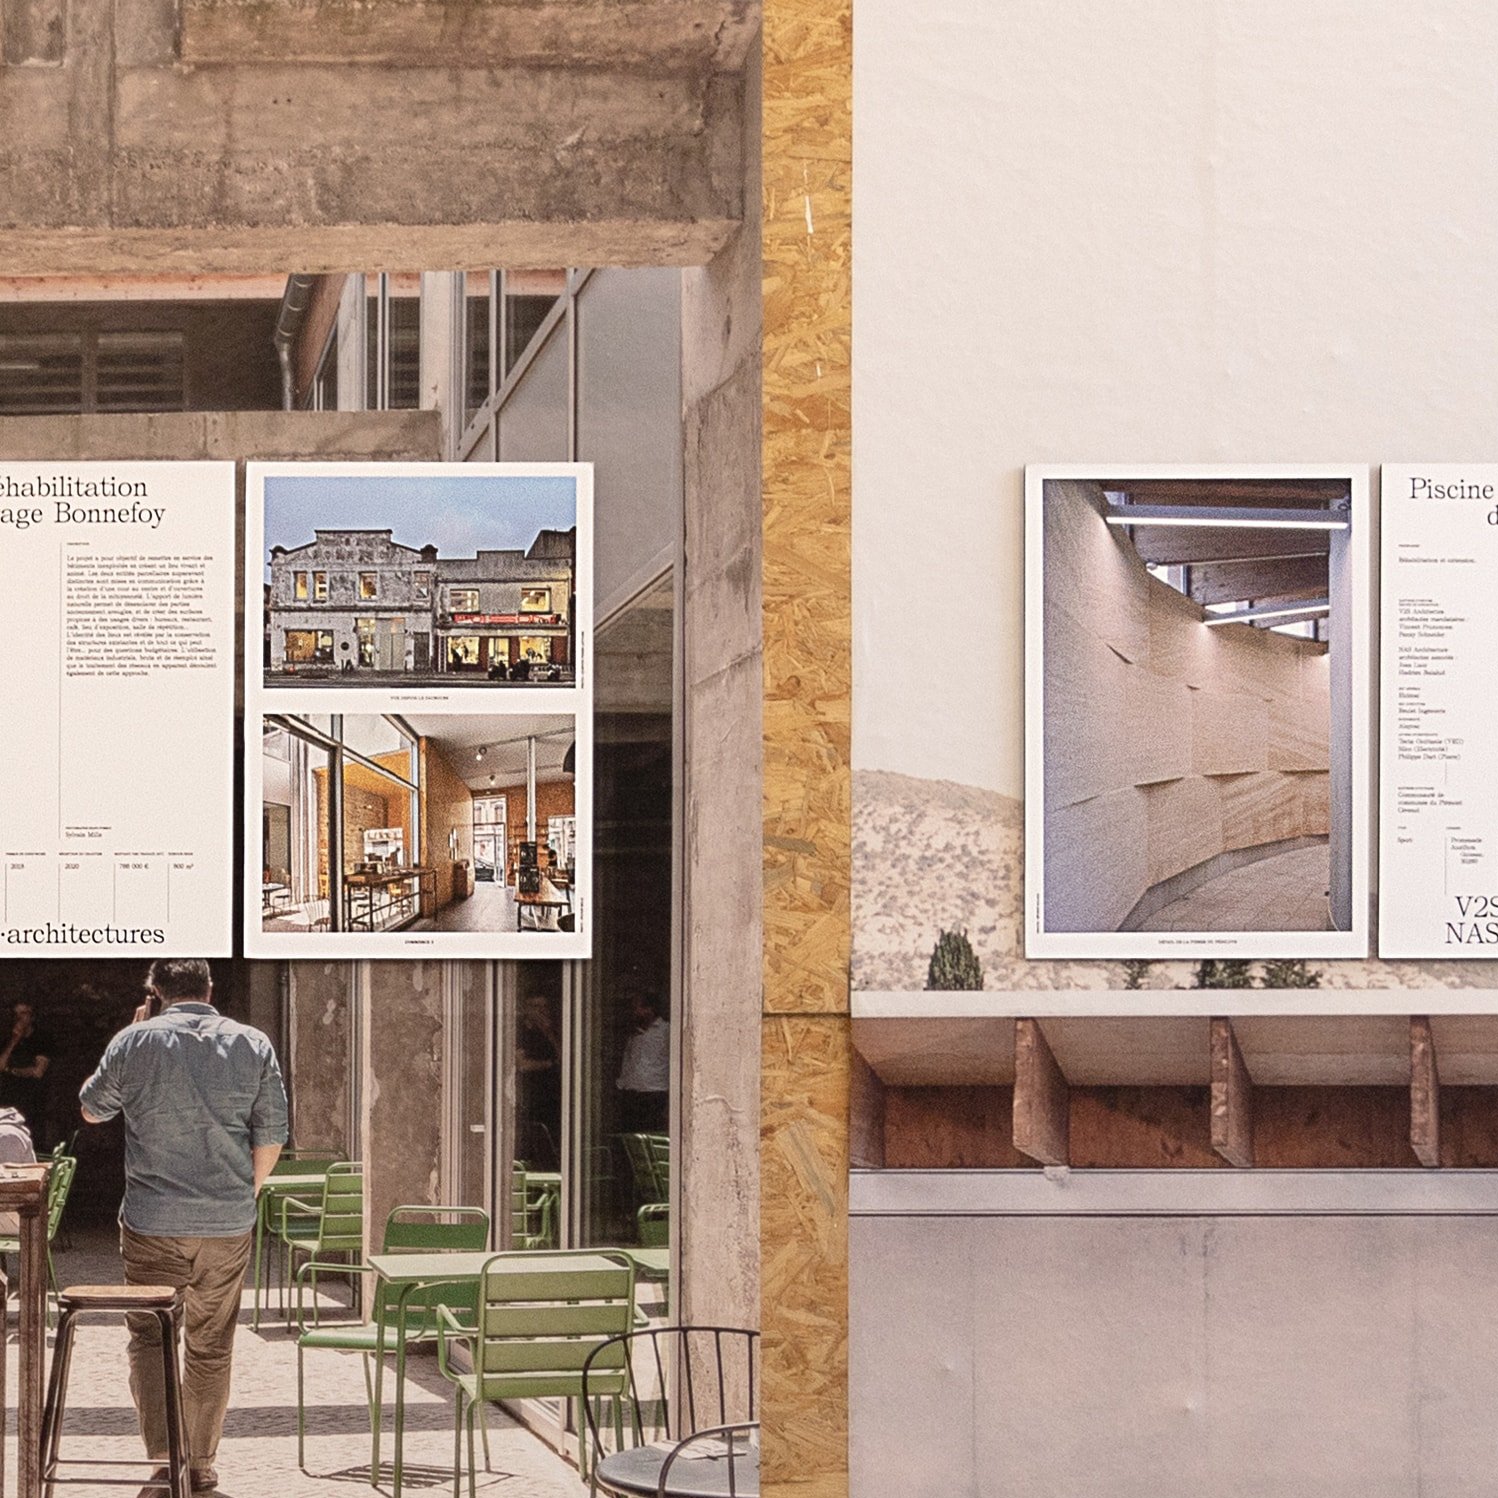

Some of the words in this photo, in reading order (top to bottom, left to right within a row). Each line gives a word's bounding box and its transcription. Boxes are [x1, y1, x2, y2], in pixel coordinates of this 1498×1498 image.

[1409, 478, 1494, 499] Piscine
[1, 508, 42, 529] age
[54, 501, 166, 529] Bonnefoy
